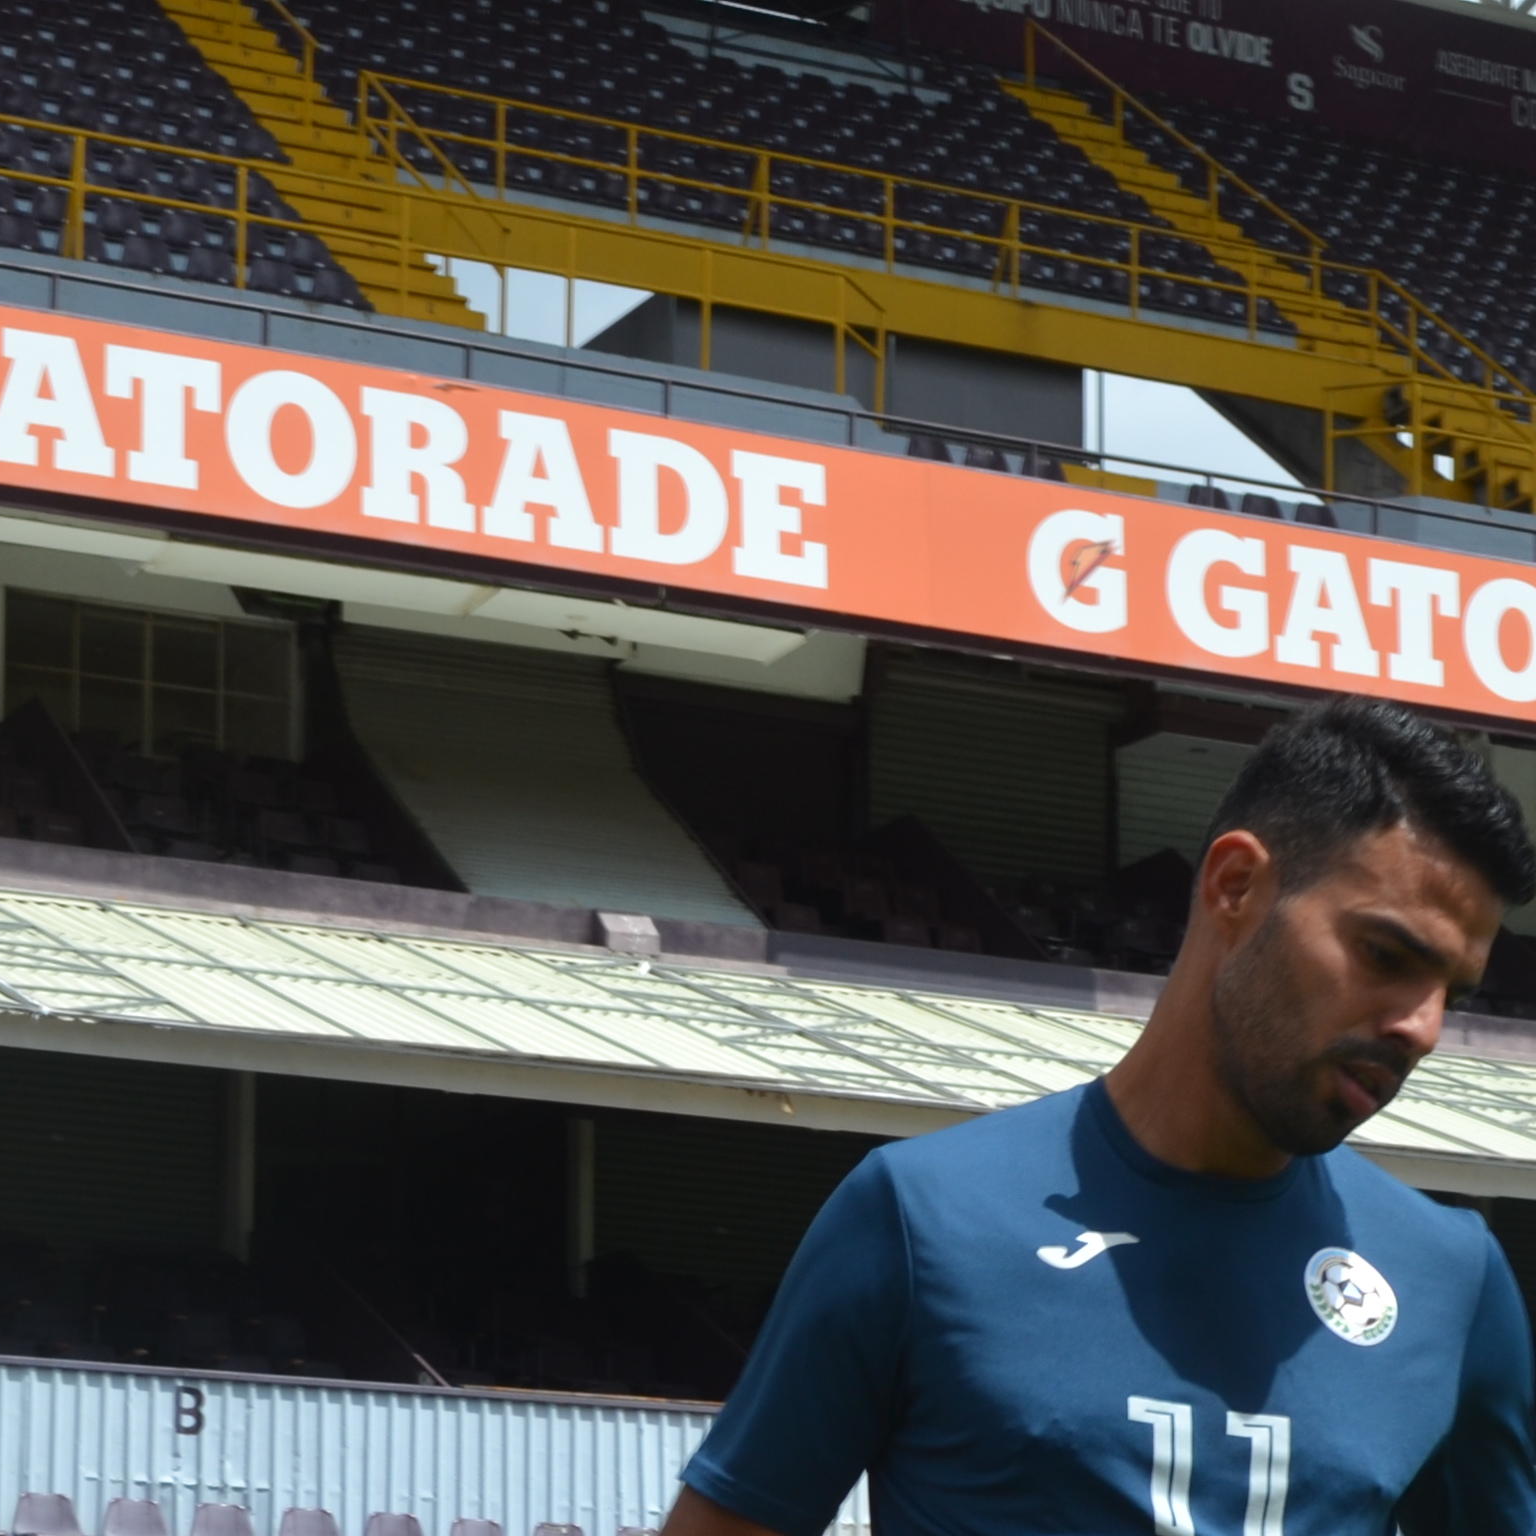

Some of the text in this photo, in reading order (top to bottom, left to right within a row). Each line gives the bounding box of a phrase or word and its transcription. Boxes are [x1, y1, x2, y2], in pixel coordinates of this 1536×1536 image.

[1149, 12, 1181, 48] TE
[1186, 21, 1274, 67] OLVIDE
[1286, 72, 1316, 111] S
[1026, 509, 1128, 634] G
[175, 1386, 205, 1435] B
